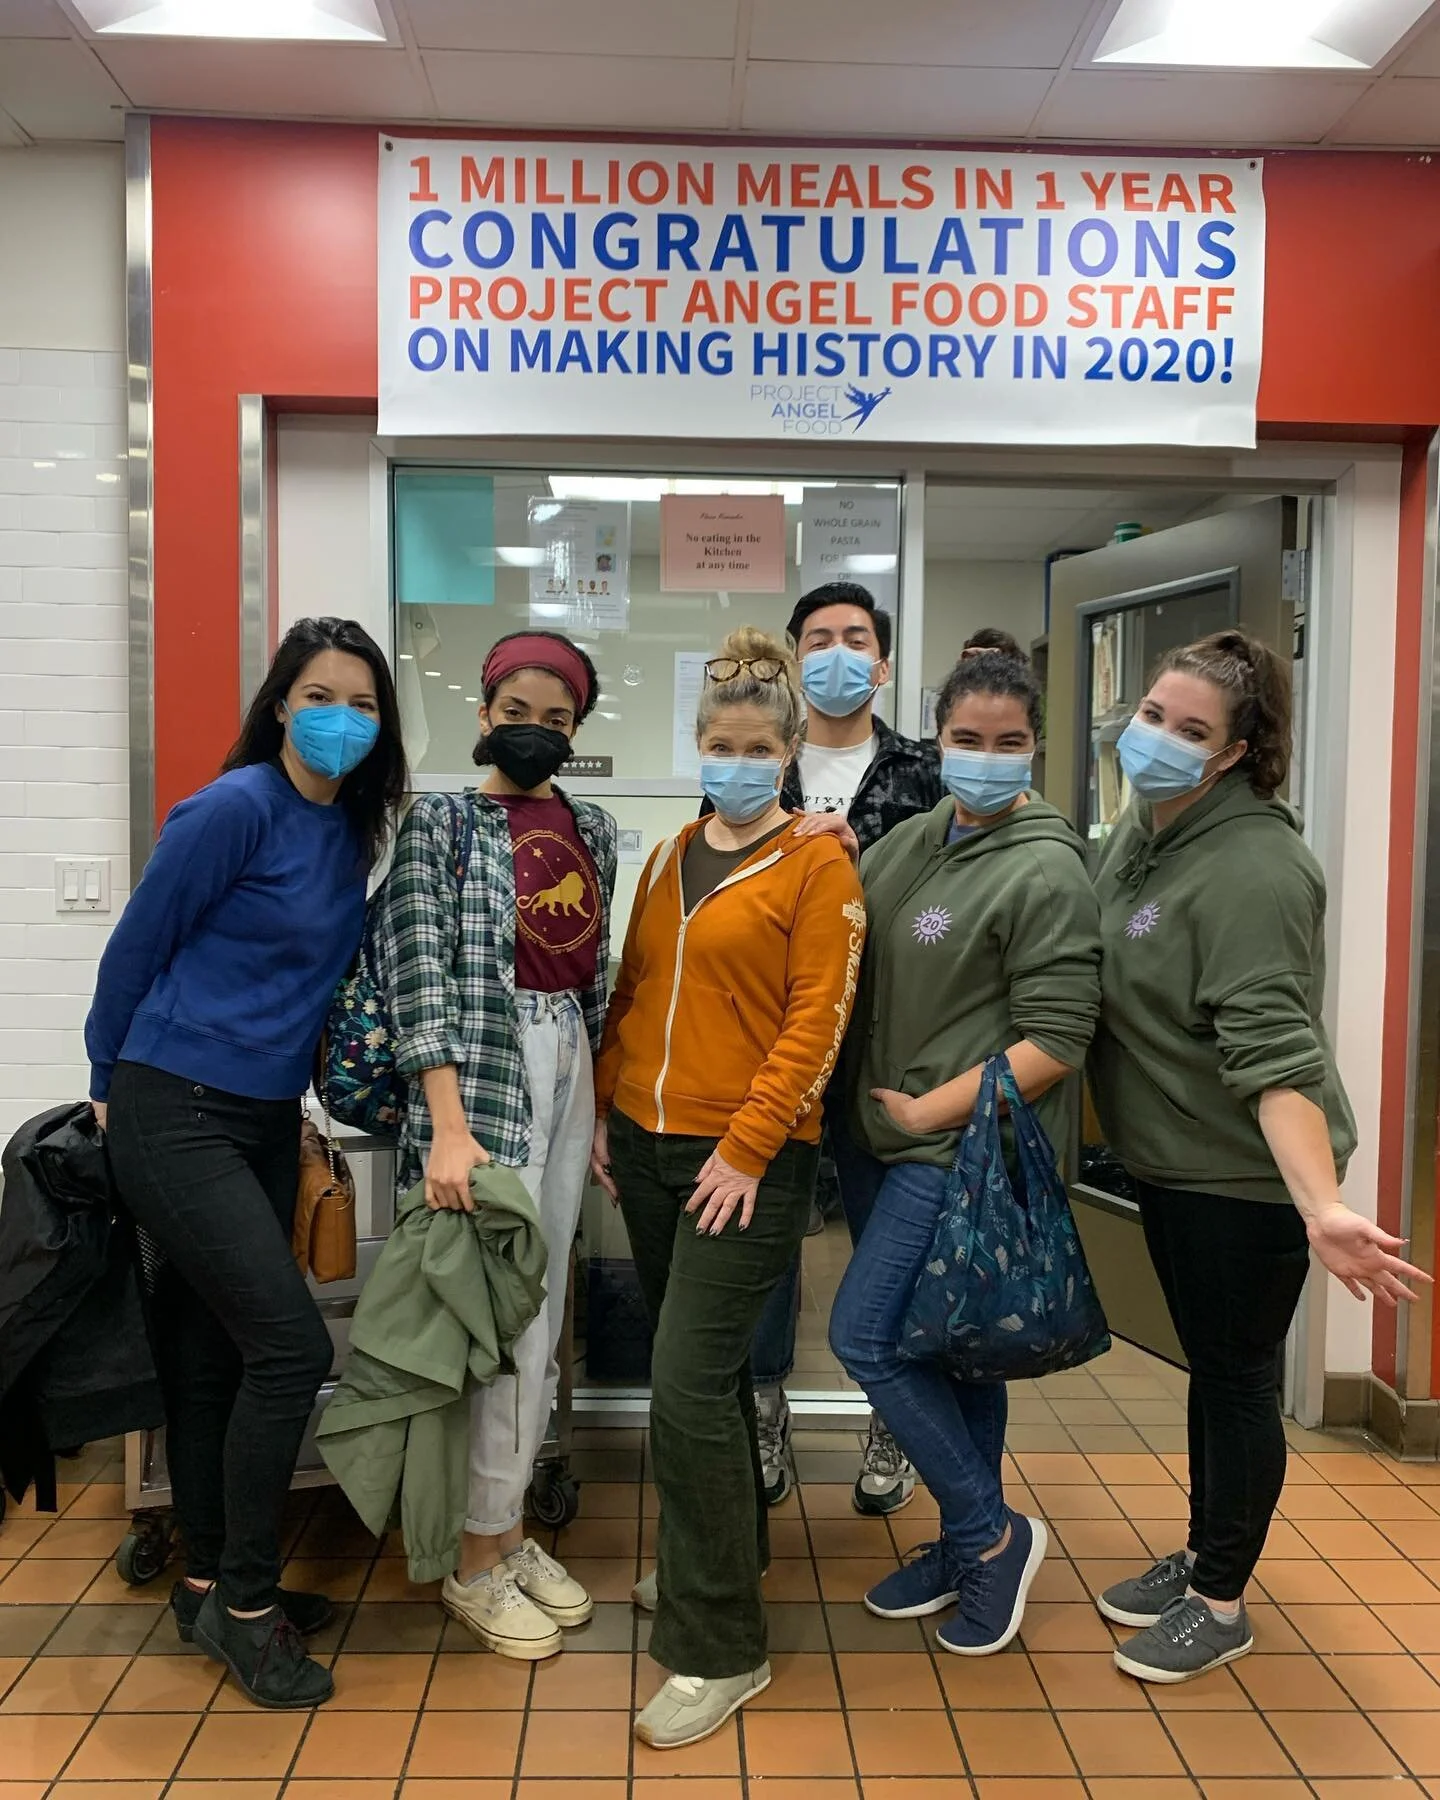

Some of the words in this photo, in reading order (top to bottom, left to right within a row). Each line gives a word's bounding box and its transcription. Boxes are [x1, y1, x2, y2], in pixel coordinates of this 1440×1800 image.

[409, 155, 439, 202] 1
[461, 155, 714, 205] MILLION
[737, 163, 935, 210] MEALS
[954, 167, 1013, 210] IN
[1035, 171, 1066, 210] 1
[1081, 171, 1237, 214] YEAR
[408, 209, 1237, 281] CONGRATULATIONS
[409, 275, 668, 323] PROJECT
[682, 279, 873, 326] ANGEL
[891, 281, 1049, 328] FOOD
[1067, 284, 1236, 331] STAFF
[408, 327, 490, 373] ON
[510, 328, 734, 377] MAKING
[753, 331, 997, 379] HISTORY
[1012, 335, 1068, 381] IN
[1084, 336, 1235, 384] 2020!
[750, 384, 841, 401] PROJECT
[771, 403, 841, 418] ANGEL
[783, 420, 842, 434] FOOD
[839, 500, 854, 510] NO
[813, 518, 848, 528] WHOLE
[850, 519, 881, 528] GRAIN
[686, 532, 699, 542] No
[701, 533, 731, 545] eating
[734, 532, 743, 542] in
[746, 533, 761, 543] the
[830, 536, 860, 545] PASTA
[704, 547, 742, 556] Kitchen
[696, 561, 705, 569] at
[708, 562, 725, 571] any
[729, 561, 750, 569] time
[922, 917, 940, 931] 20
